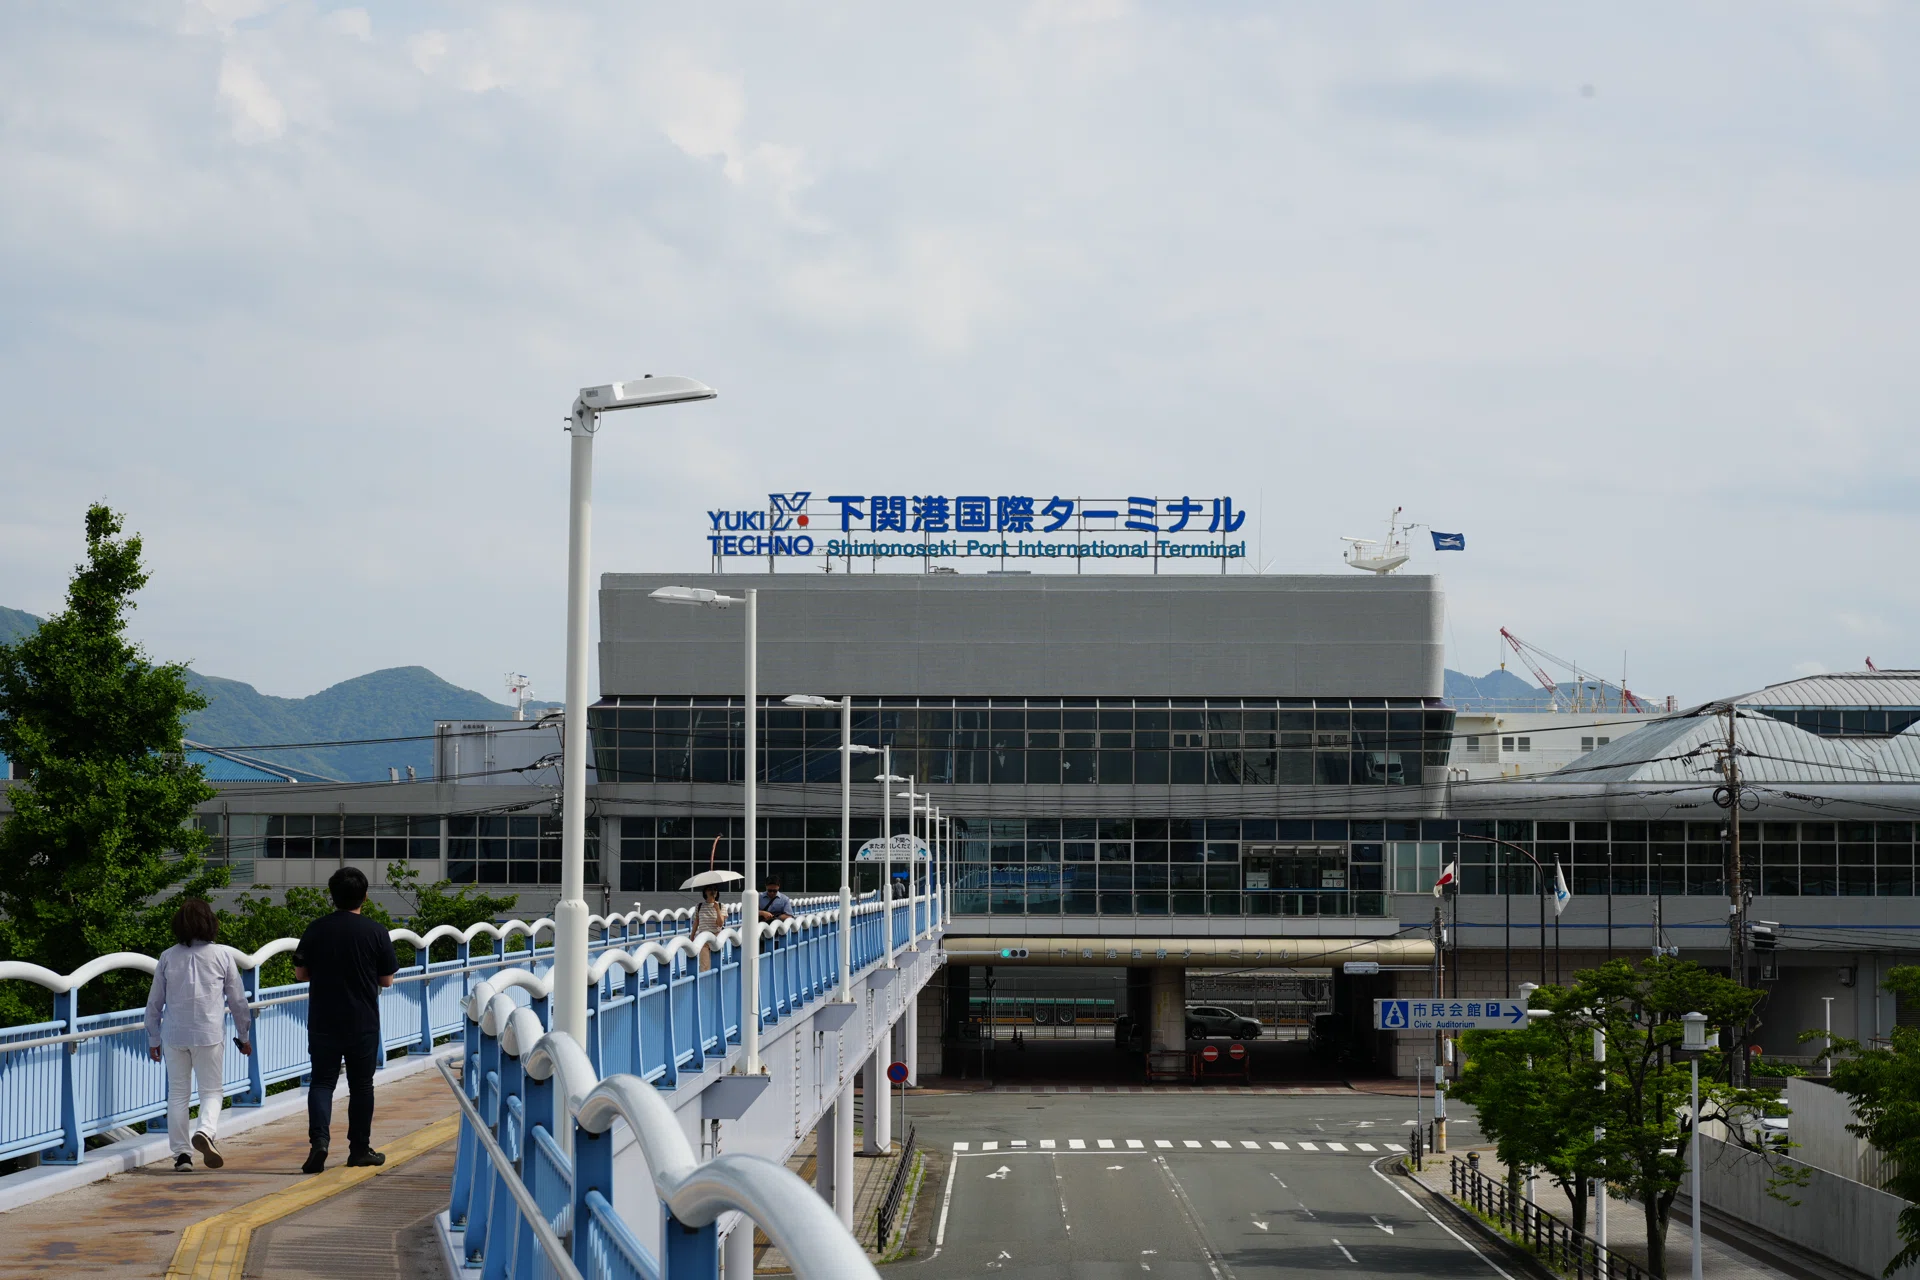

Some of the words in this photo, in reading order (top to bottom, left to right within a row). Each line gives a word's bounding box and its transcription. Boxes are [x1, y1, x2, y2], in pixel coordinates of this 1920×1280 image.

[707, 511, 765, 531] YUKI
[828, 496, 1246, 533] 下関港国際ターミナル
[707, 535, 814, 555] TECHNO
[827, 539, 957, 557] Shimonoseki
[967, 540, 1009, 557] Port
[1018, 540, 1148, 557] International
[1157, 540, 1246, 557] Terminal
[1058, 948, 1290, 959] 下関港国際ターミナル
[1413, 1003, 1482, 1017] 市民会館
[1487, 1004, 1498, 1016] P
[1414, 1020, 1432, 1029] Civic
[1436, 1020, 1476, 1029] Auditorium
